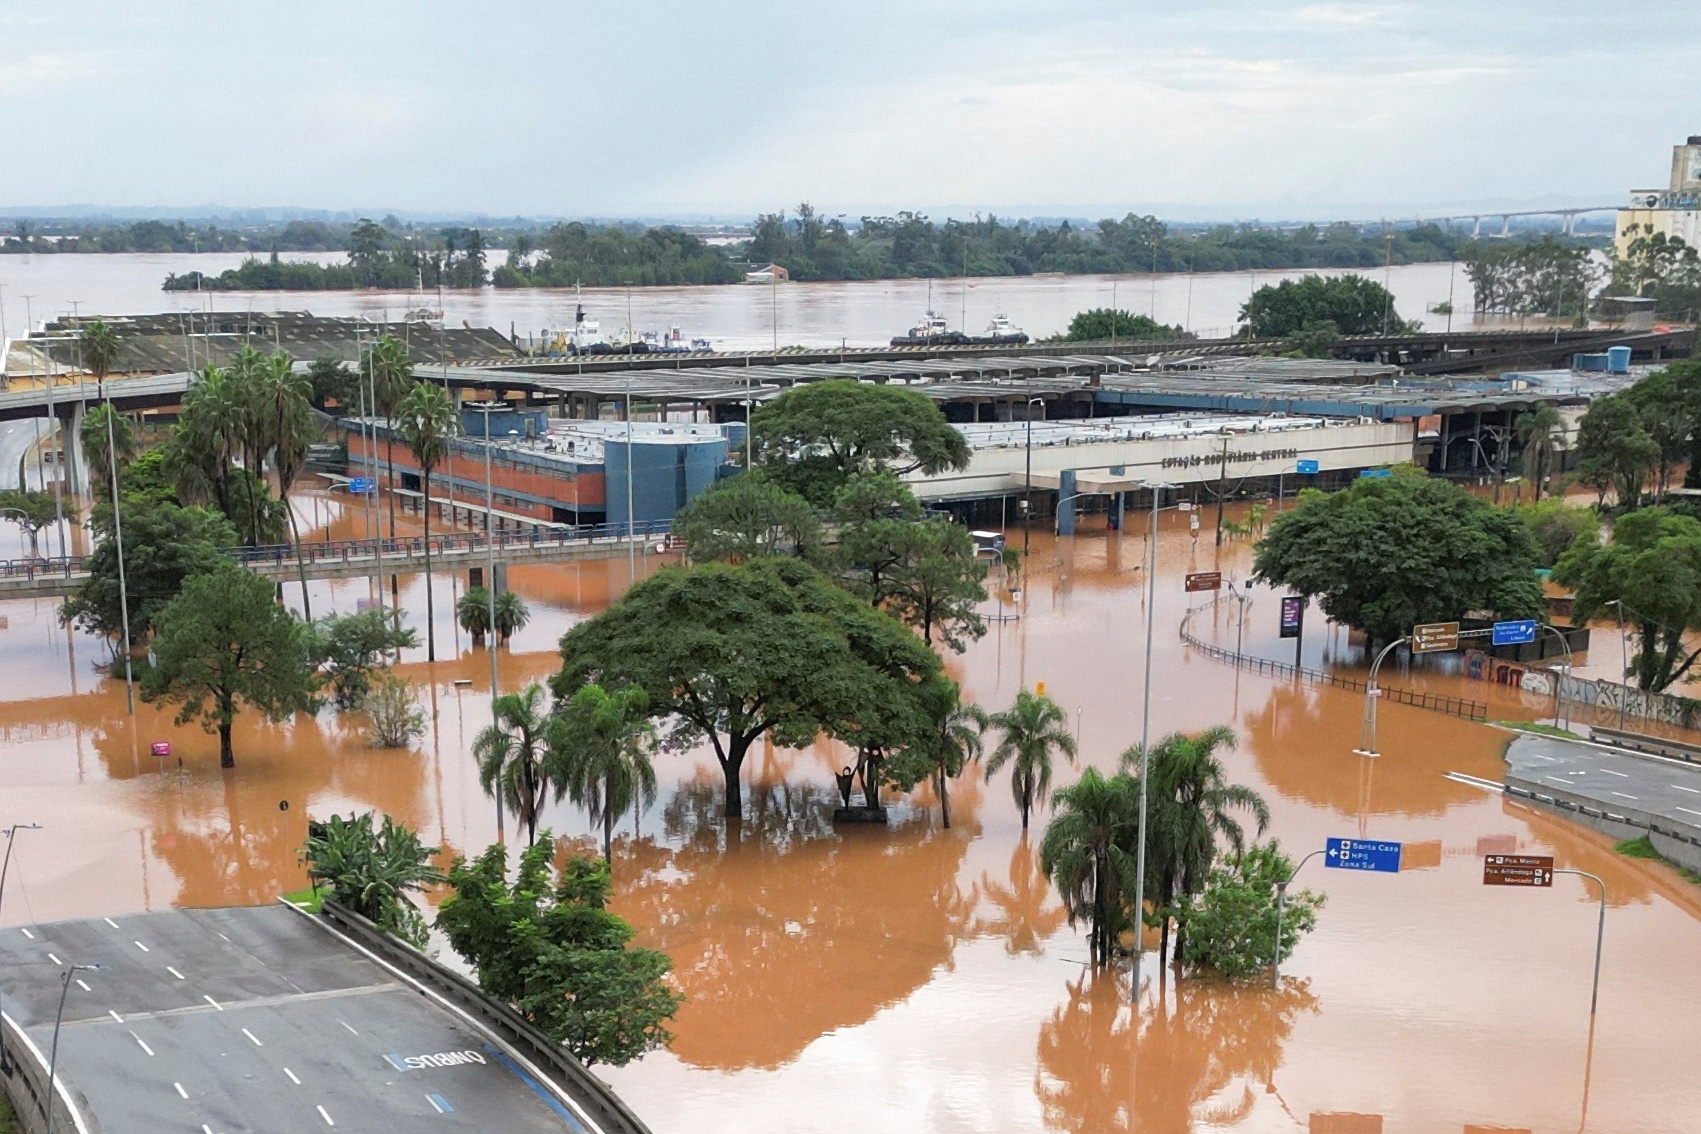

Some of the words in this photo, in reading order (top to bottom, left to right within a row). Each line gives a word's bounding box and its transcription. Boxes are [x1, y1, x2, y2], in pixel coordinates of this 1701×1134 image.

[1161, 454, 1200, 470] ESTAÇÃO
[1204, 450, 1257, 466] RODVIÁRIA
[1261, 448, 1298, 461] CENTRAL
[1352, 842, 1376, 851] Santa
[1378, 844, 1399, 853] Casa
[1351, 852, 1369, 860] HPS
[1339, 860, 1360, 868] Zona
[1361, 861, 1376, 869] Sul
